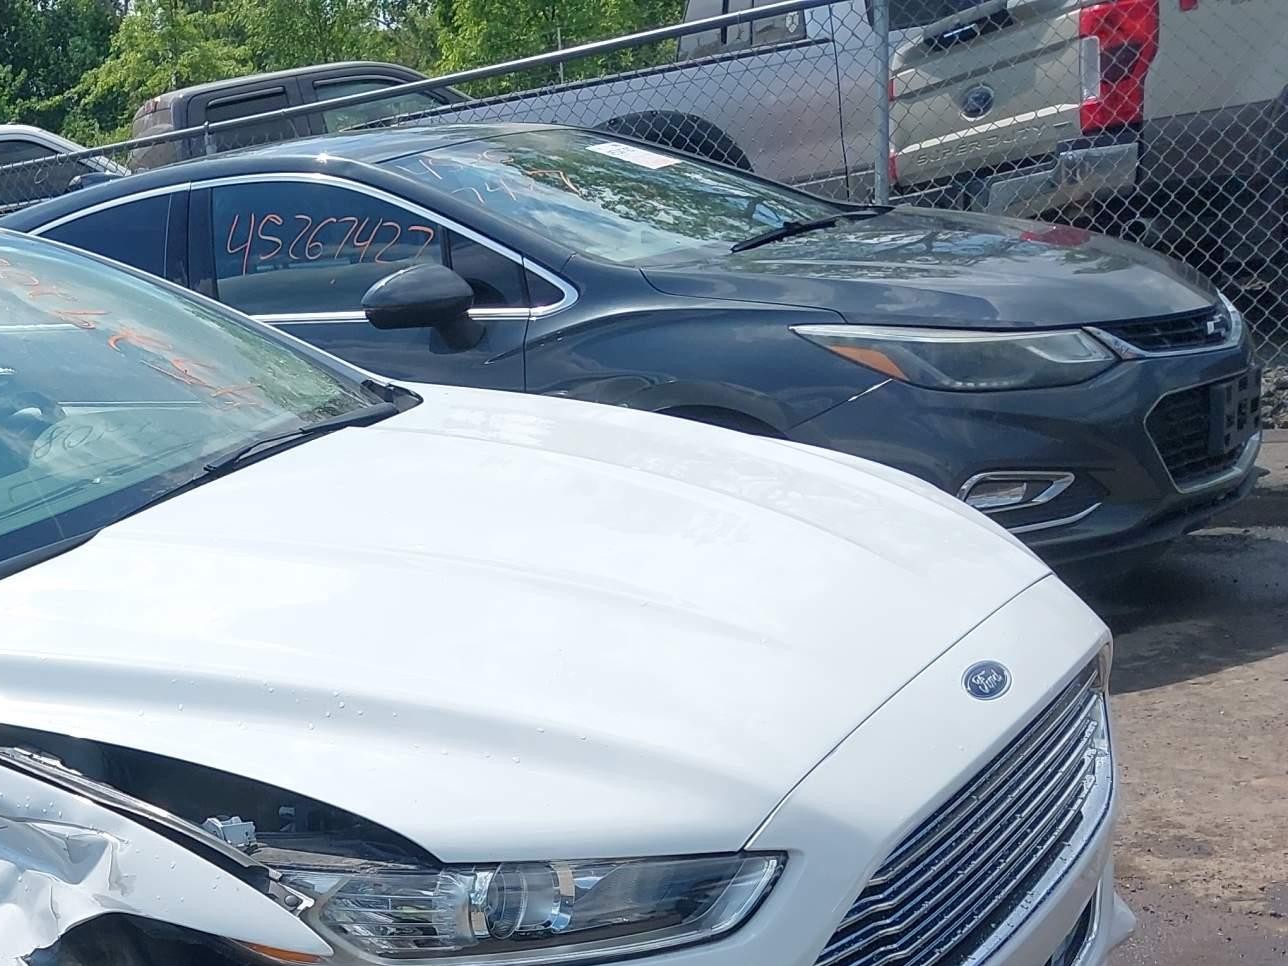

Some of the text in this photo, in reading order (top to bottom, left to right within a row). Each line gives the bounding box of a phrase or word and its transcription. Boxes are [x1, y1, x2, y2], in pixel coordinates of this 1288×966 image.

[916, 123, 1048, 165] SUPER DUTY
[227, 213, 435, 276] 45267427
